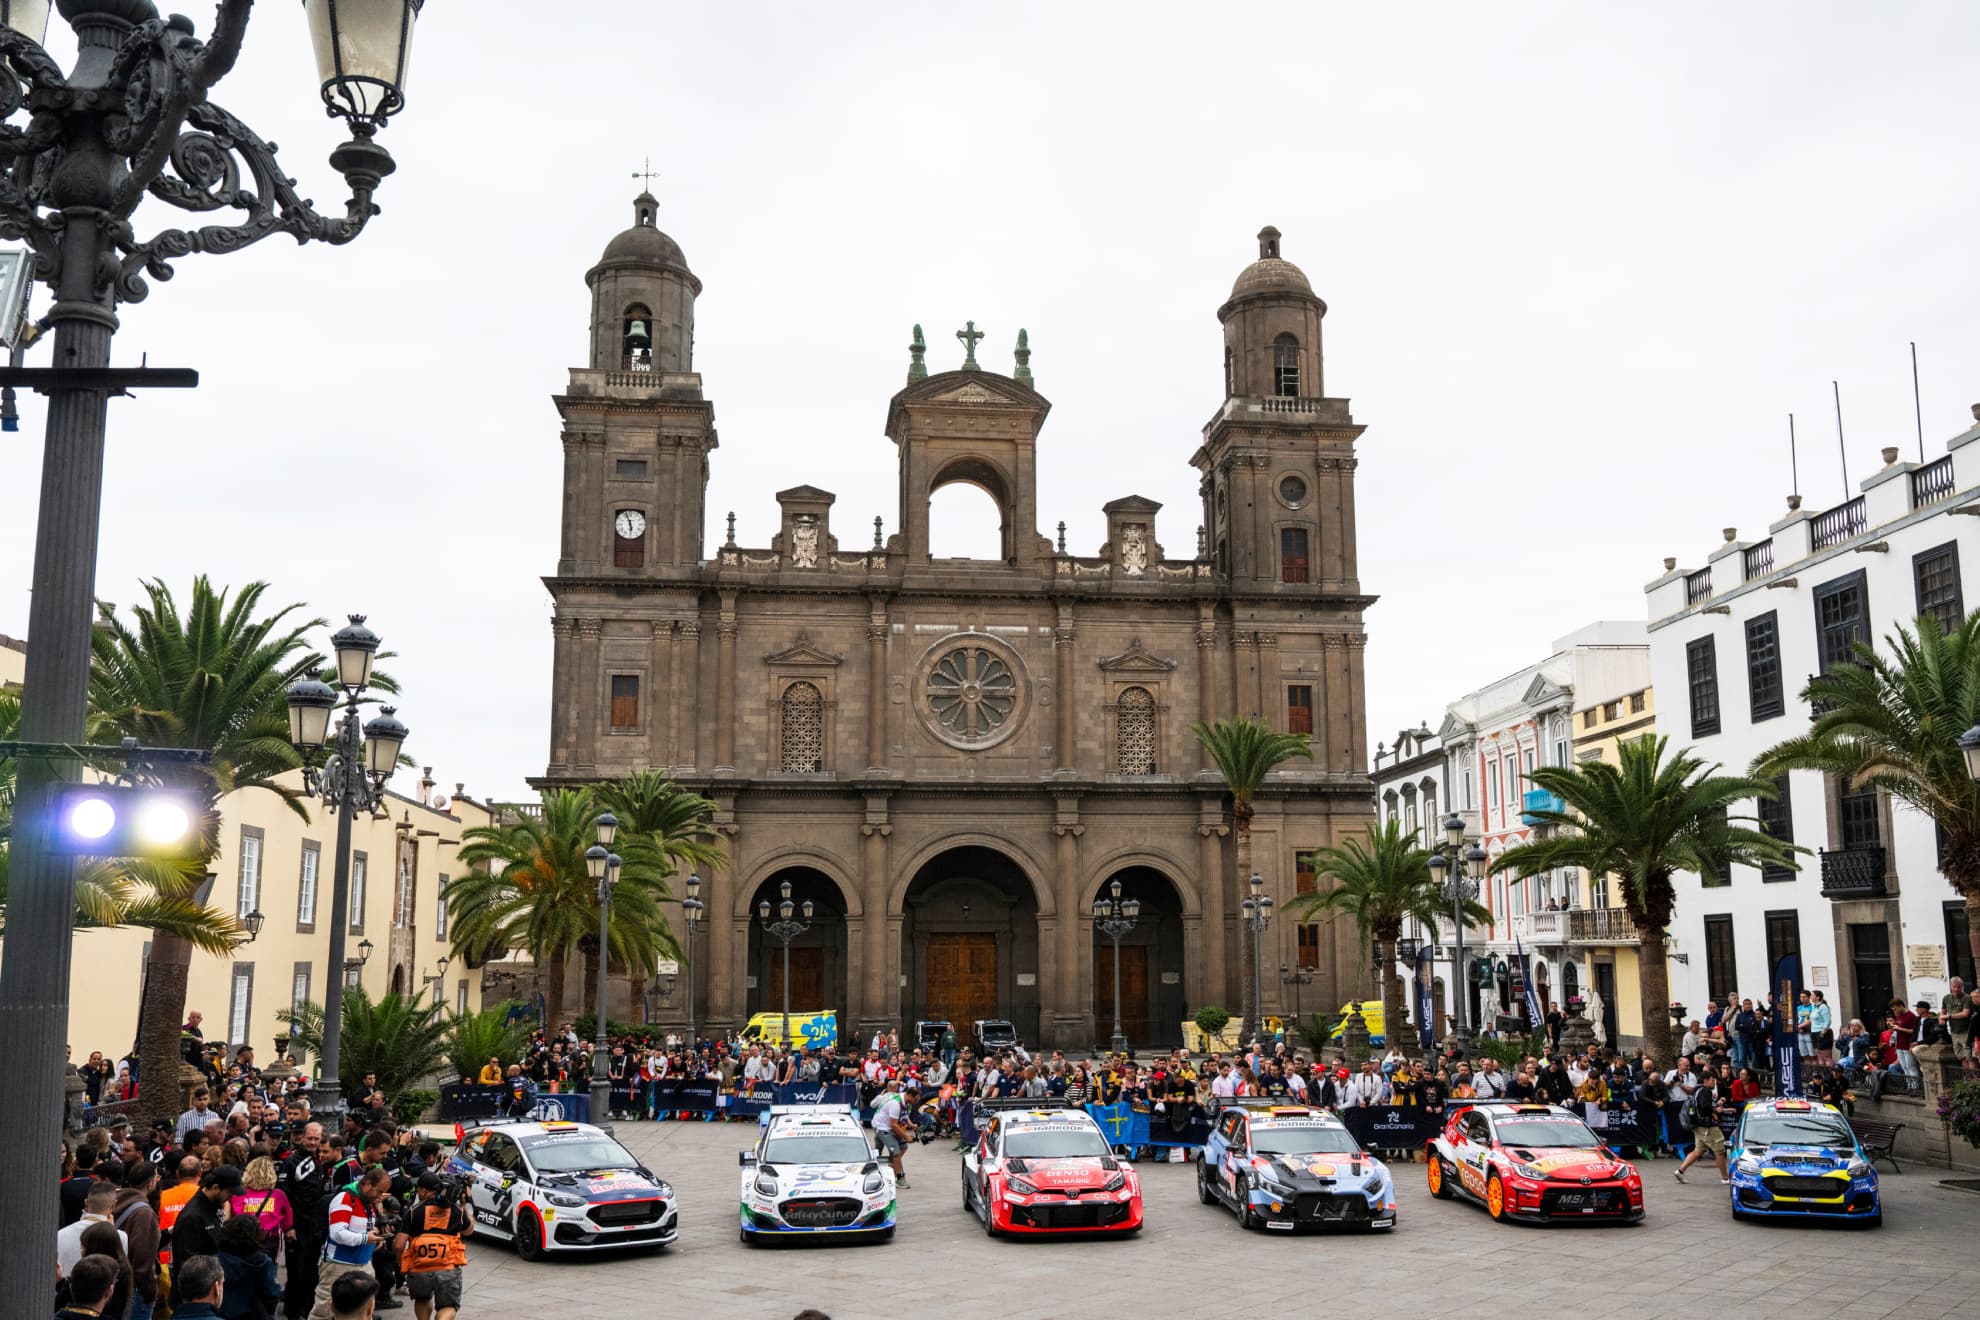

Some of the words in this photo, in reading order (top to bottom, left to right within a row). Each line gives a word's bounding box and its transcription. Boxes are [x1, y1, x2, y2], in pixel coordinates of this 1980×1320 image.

[588, 1182, 621, 1194] Red
[622, 1179, 655, 1190] Bull
[417, 1243, 447, 1259] 057
